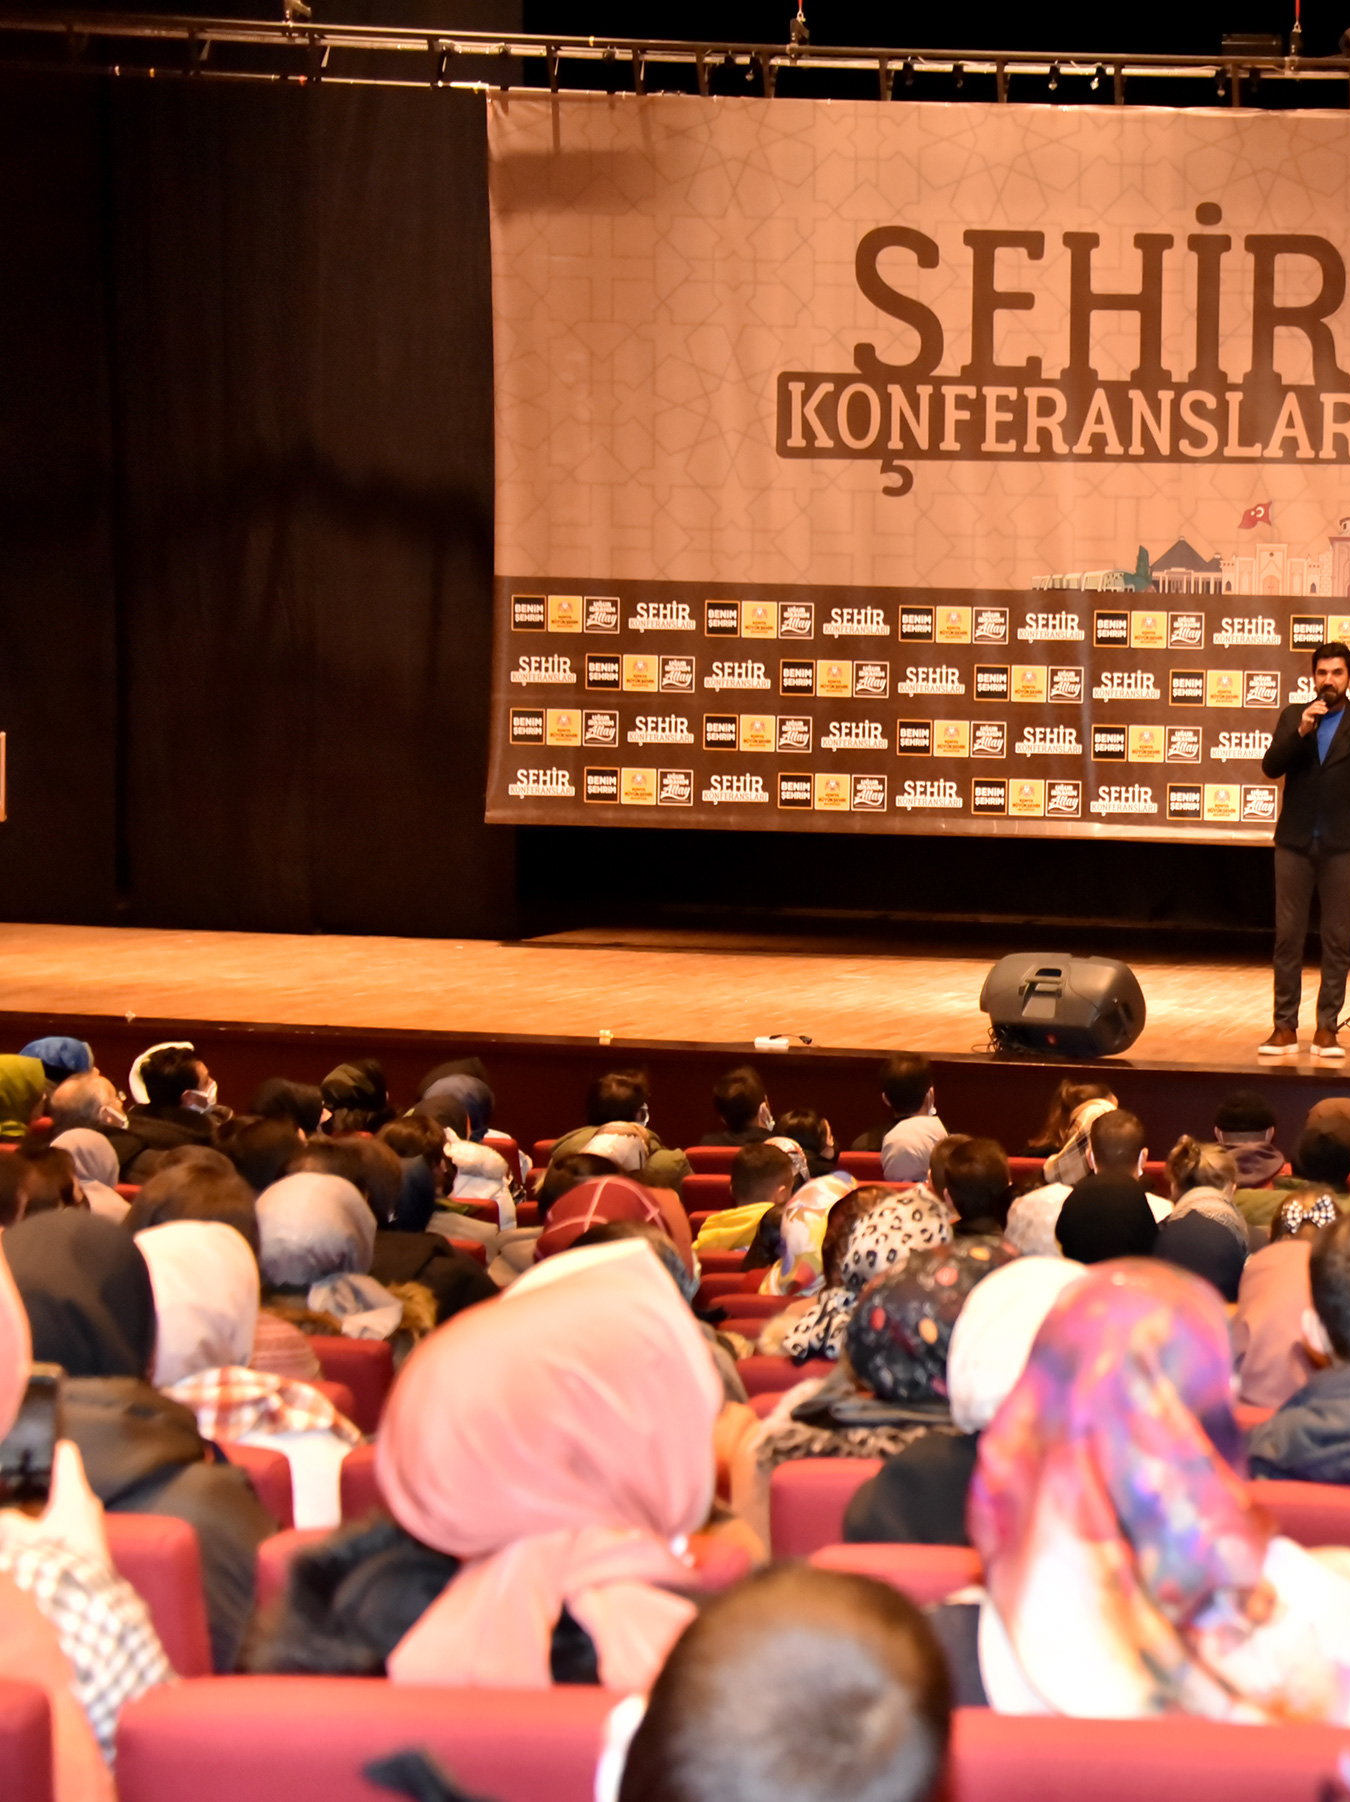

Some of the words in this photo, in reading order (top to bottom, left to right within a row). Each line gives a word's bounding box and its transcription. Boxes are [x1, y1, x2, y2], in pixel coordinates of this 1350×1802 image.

[630, 619, 694, 629] KONFERANSLARI
[824, 624, 889, 635] KONFERANSLARI
[1019, 630, 1084, 640] KONFERANSLARI
[1214, 634, 1280, 645] KONFERANSLARI
[512, 672, 576, 683] KONFERANSLARI
[705, 678, 770, 688] KONFERANSLARI
[899, 684, 964, 694] KONFERANSLARI
[1094, 688, 1159, 699] KONFERANSLARI
[629, 732, 693, 743] KONFERANSLARI
[822, 738, 887, 748] KONFERANSLARI
[1017, 744, 1081, 754] KONFERANSLARI
[510, 786, 574, 796] KONFERANSLARI
[704, 792, 768, 802] KONFERANSLARI
[897, 797, 962, 807] KONFERANSLARI
[1091, 802, 1157, 813] KONFERANSLARI
